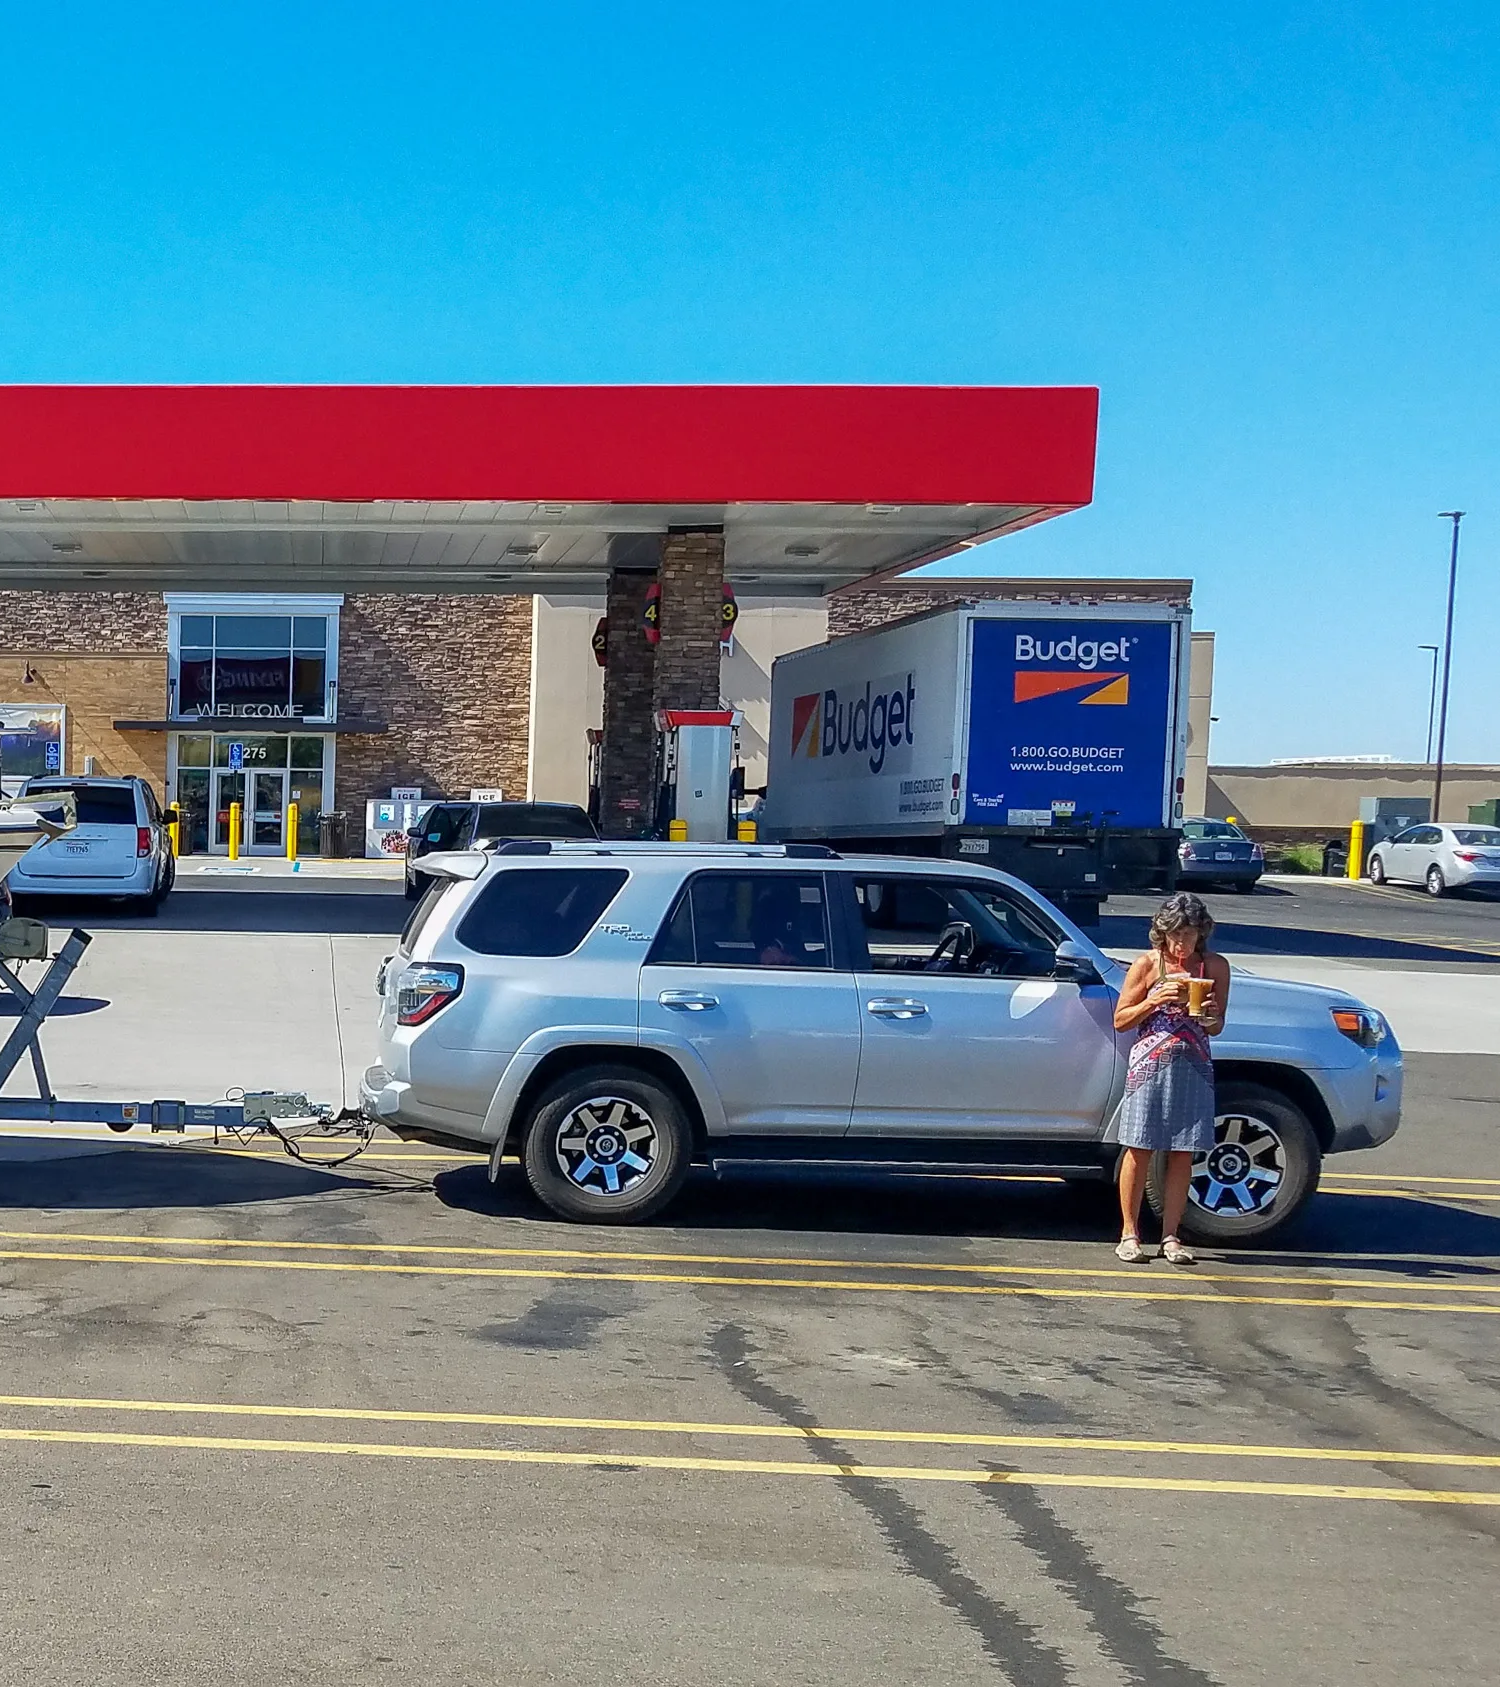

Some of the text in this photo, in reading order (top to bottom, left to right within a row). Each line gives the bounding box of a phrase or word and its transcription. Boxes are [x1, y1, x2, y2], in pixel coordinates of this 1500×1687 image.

[644, 607, 657, 621] 4
[722, 603, 734, 620] 3
[594, 635, 606, 649] 2
[1015, 634, 1130, 670] Budget
[196, 703, 304, 717] WELCOME
[822, 673, 916, 774] Budget
[1010, 746, 1125, 759] 1.800.GO.BUDGET
[1010, 760, 1124, 774] www.budget.com
